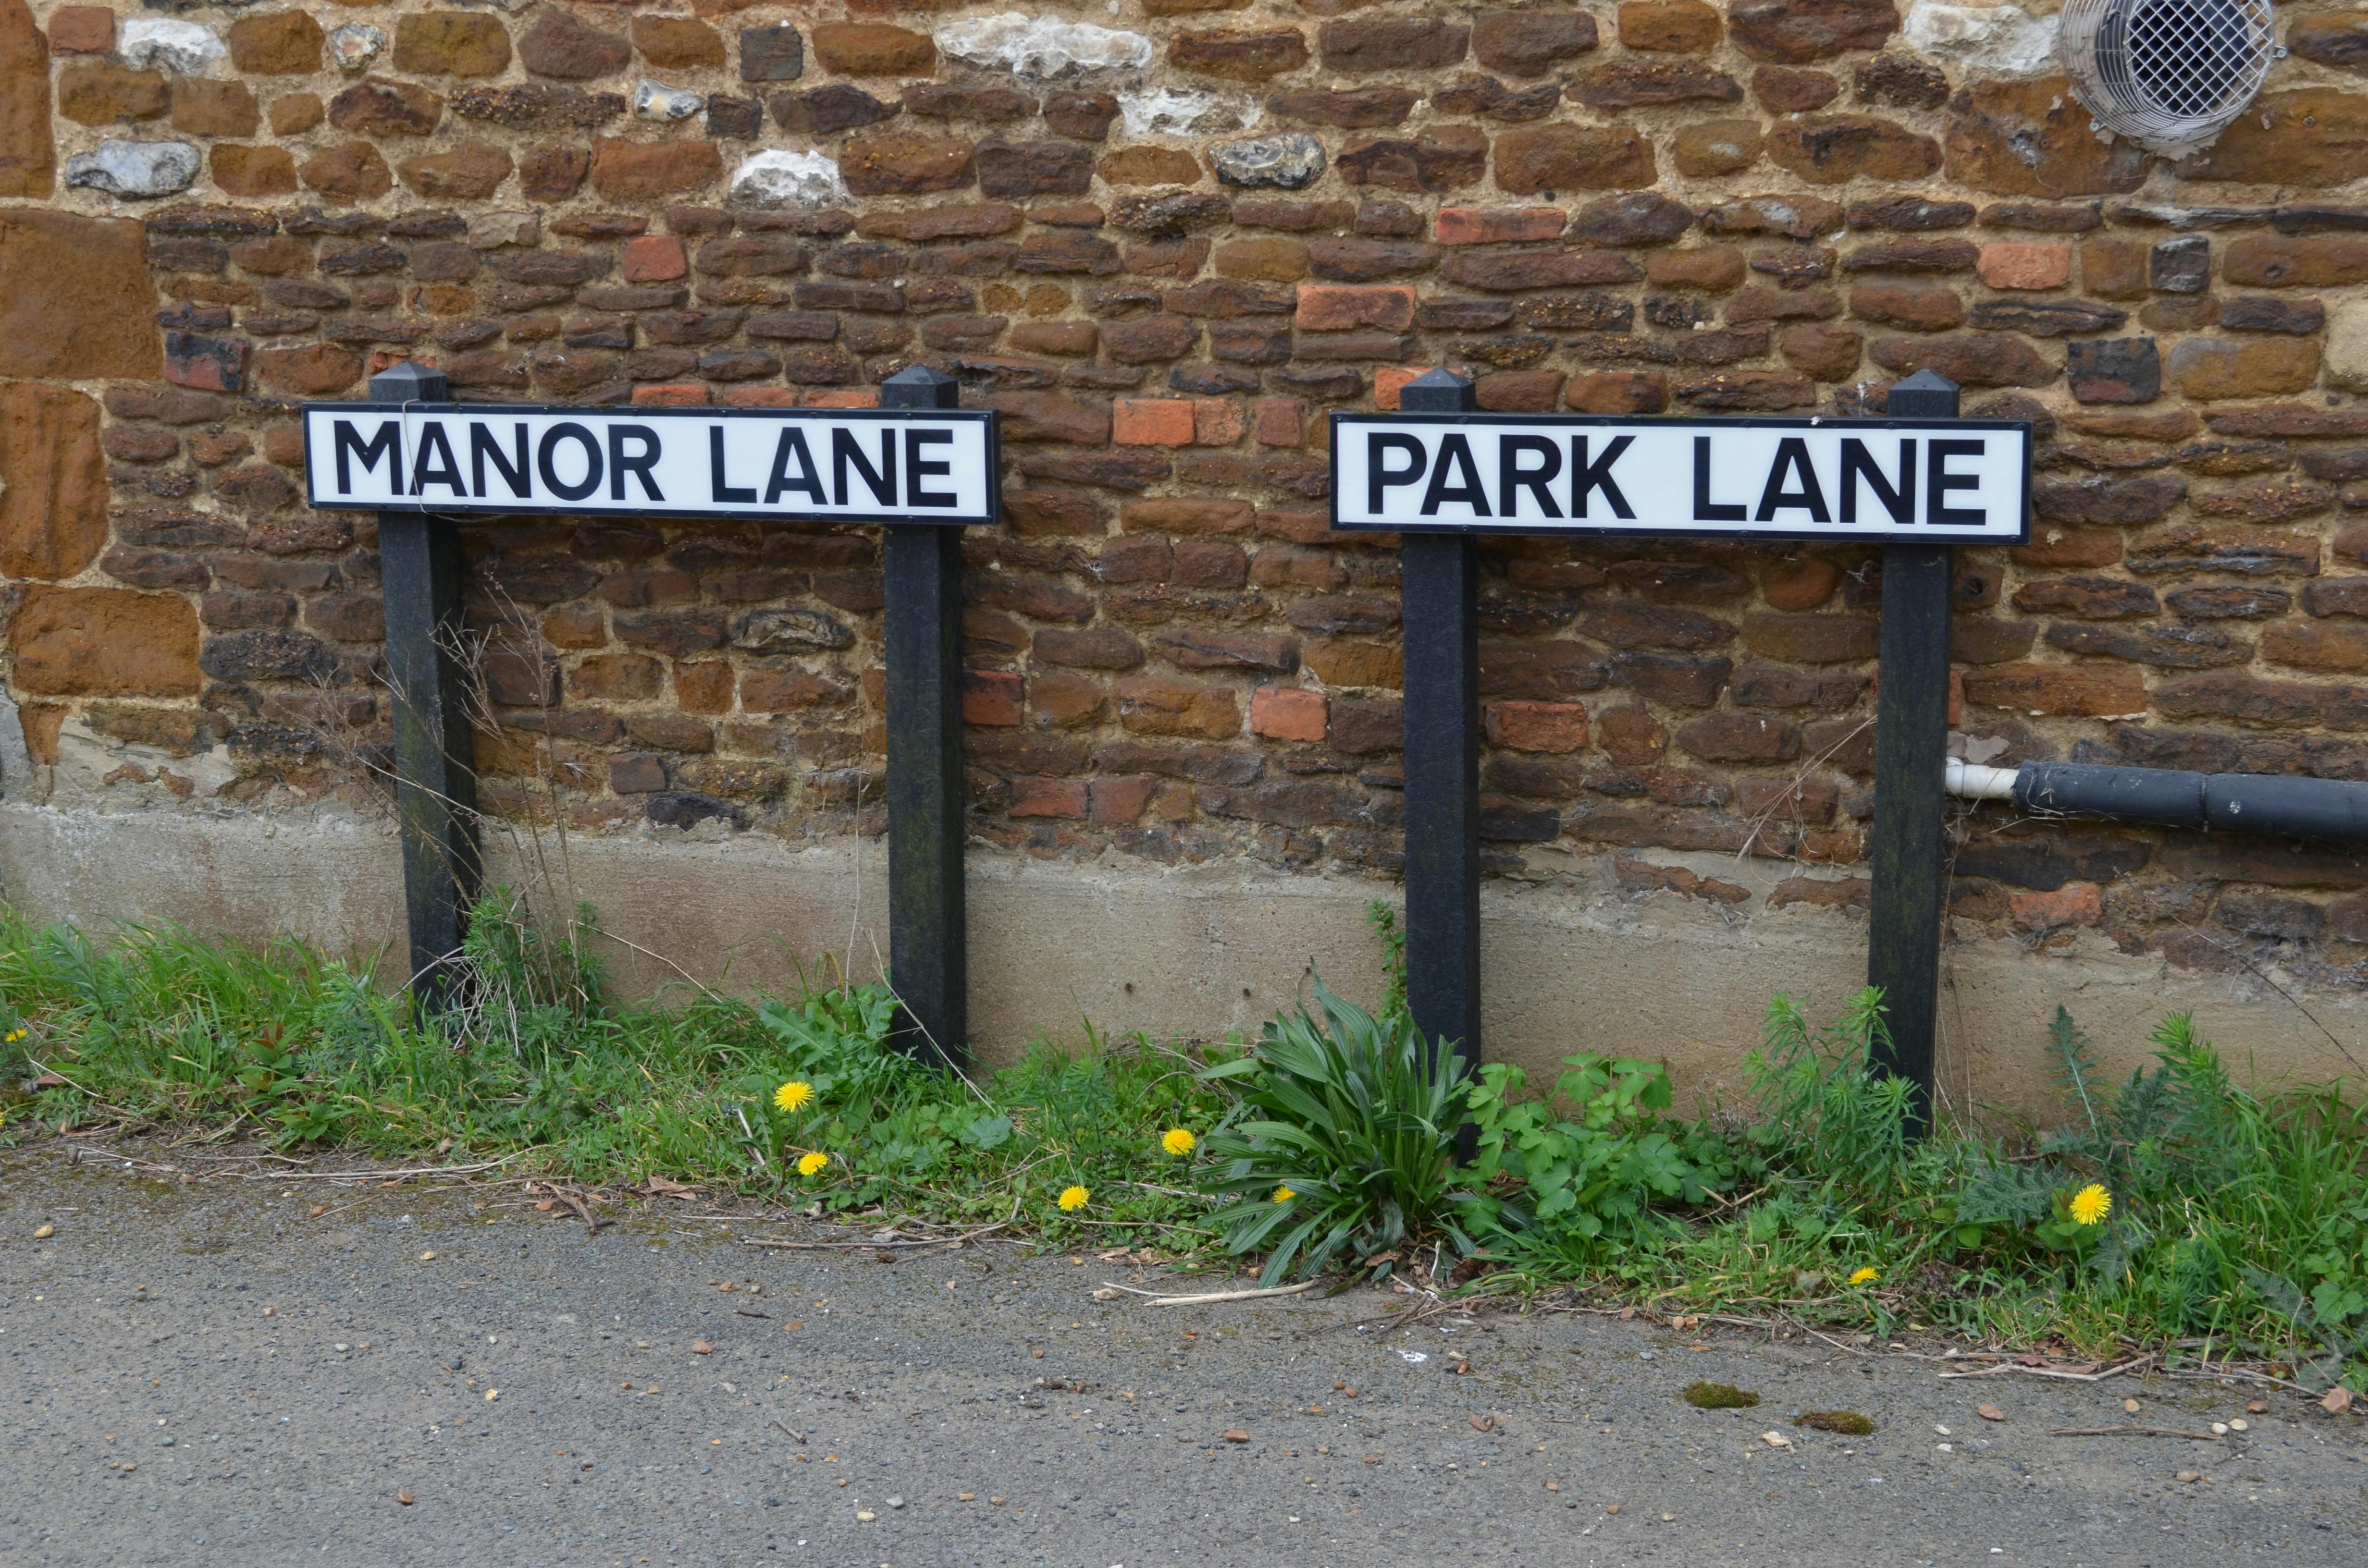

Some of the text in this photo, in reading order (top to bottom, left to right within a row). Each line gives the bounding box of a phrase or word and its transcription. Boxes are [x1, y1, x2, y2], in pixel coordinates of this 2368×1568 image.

[333, 420, 958, 508] MANOR LANE
[1367, 432, 1986, 526] PARK LANE
